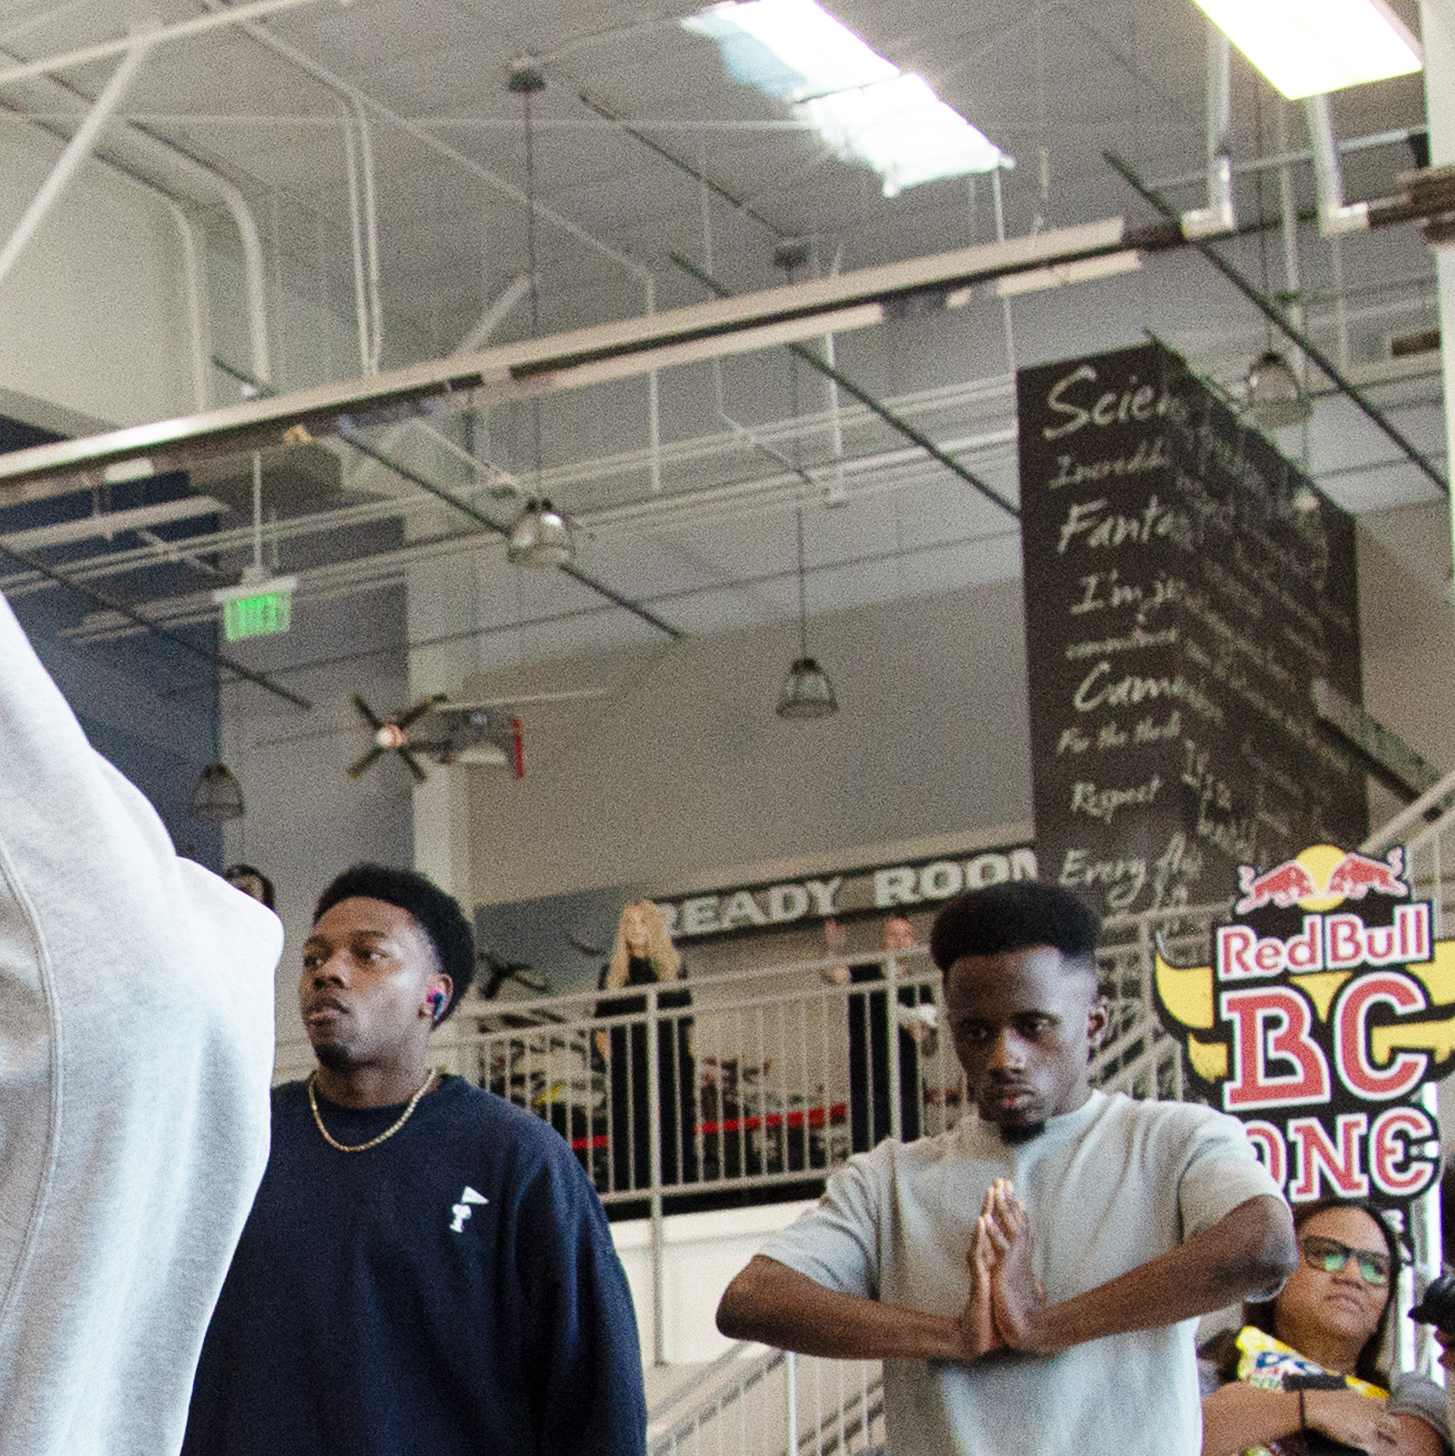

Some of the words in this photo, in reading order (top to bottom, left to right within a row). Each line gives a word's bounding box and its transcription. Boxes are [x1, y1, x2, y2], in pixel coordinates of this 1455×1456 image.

[1217, 913, 1324, 981] Red
[1325, 902, 1431, 965] Bull
[1220, 970, 1428, 1112] BC
